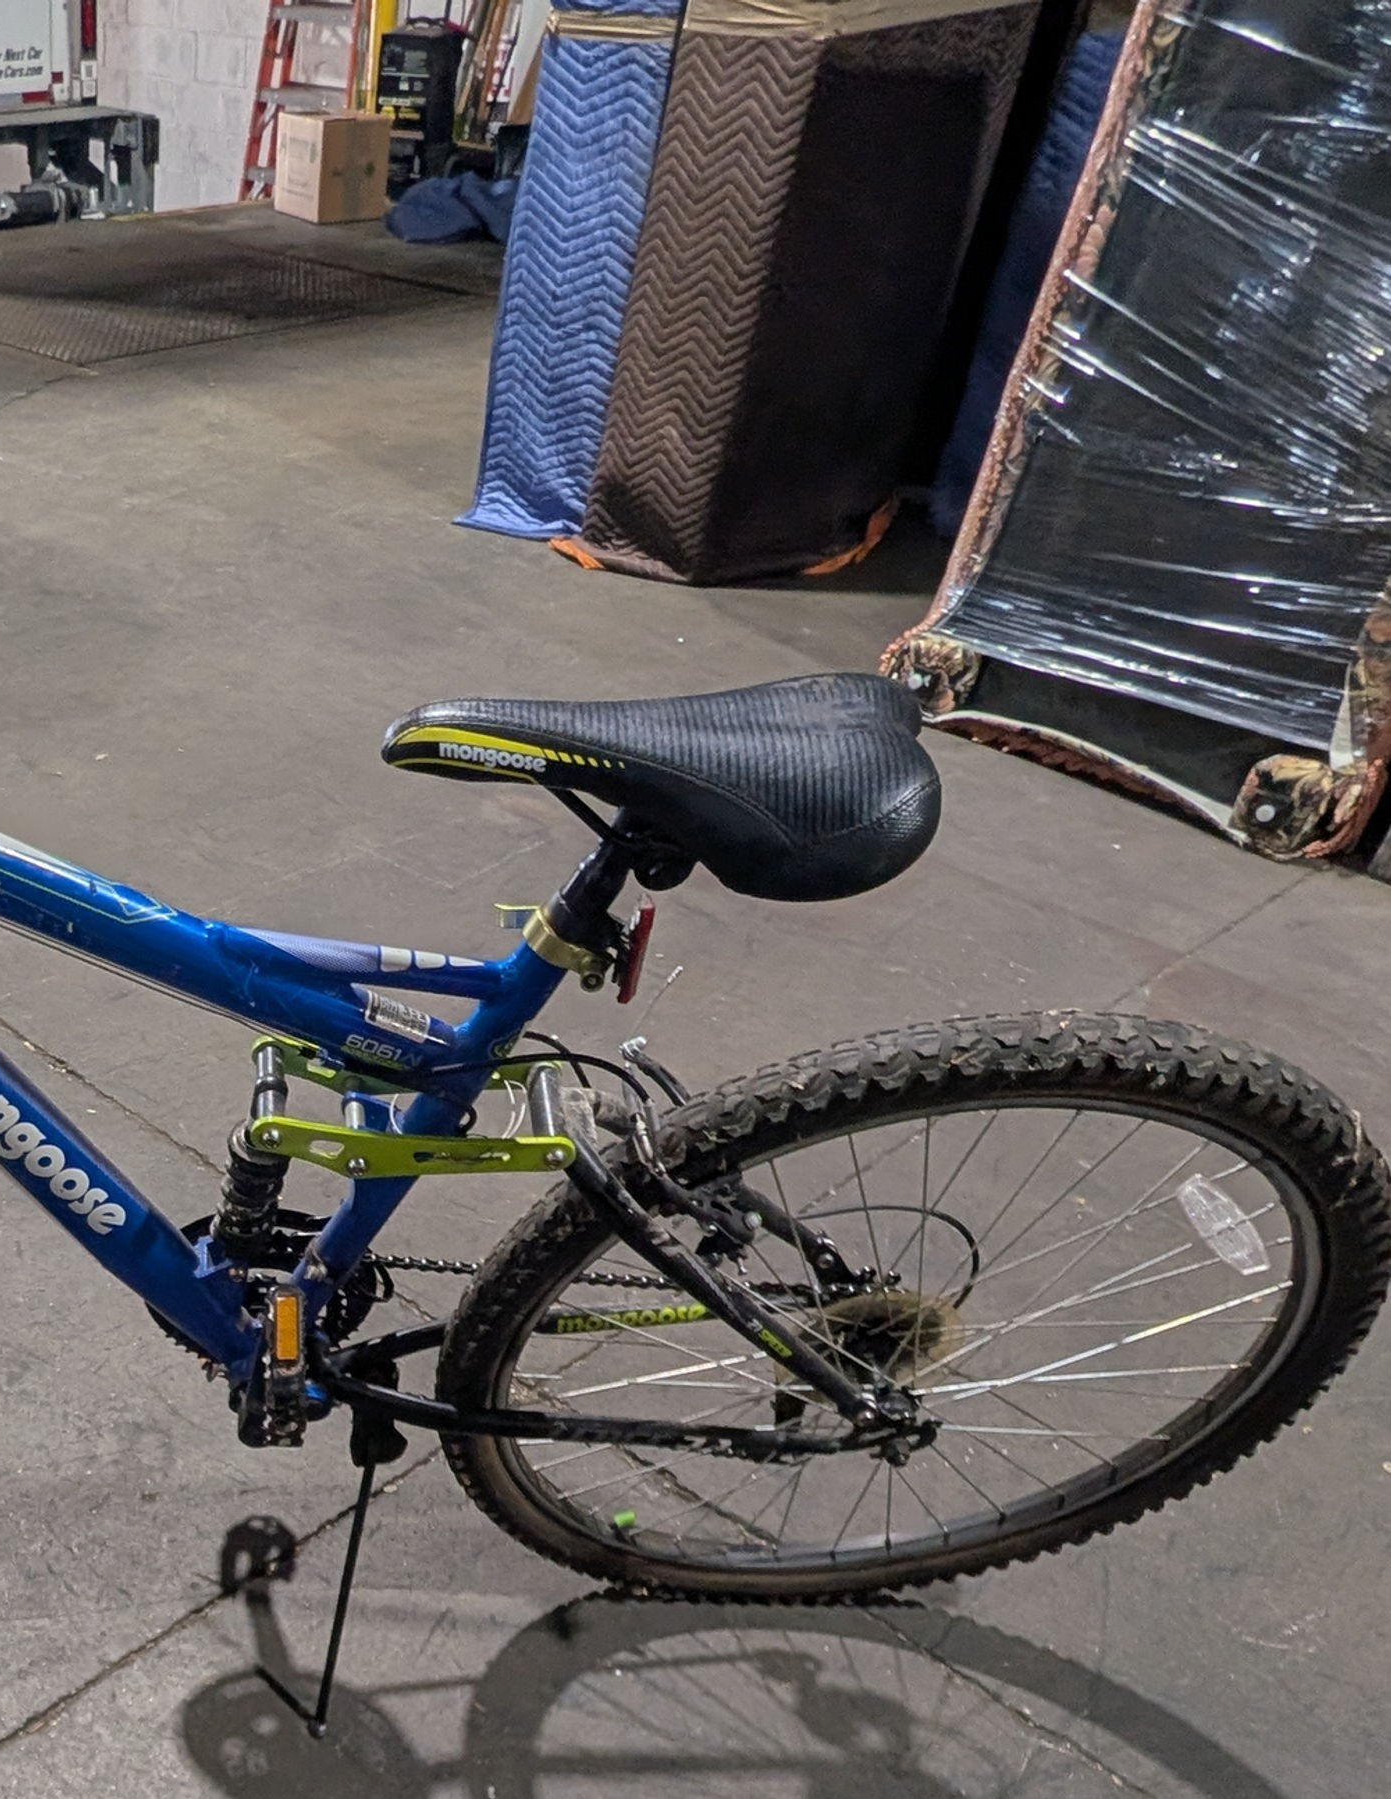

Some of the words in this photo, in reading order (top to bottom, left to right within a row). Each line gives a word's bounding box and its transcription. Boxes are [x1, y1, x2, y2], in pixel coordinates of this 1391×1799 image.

[27, 46, 43, 60] Car
[439, 741, 548, 773] mongoose
[346, 1033, 403, 1061] 6061
